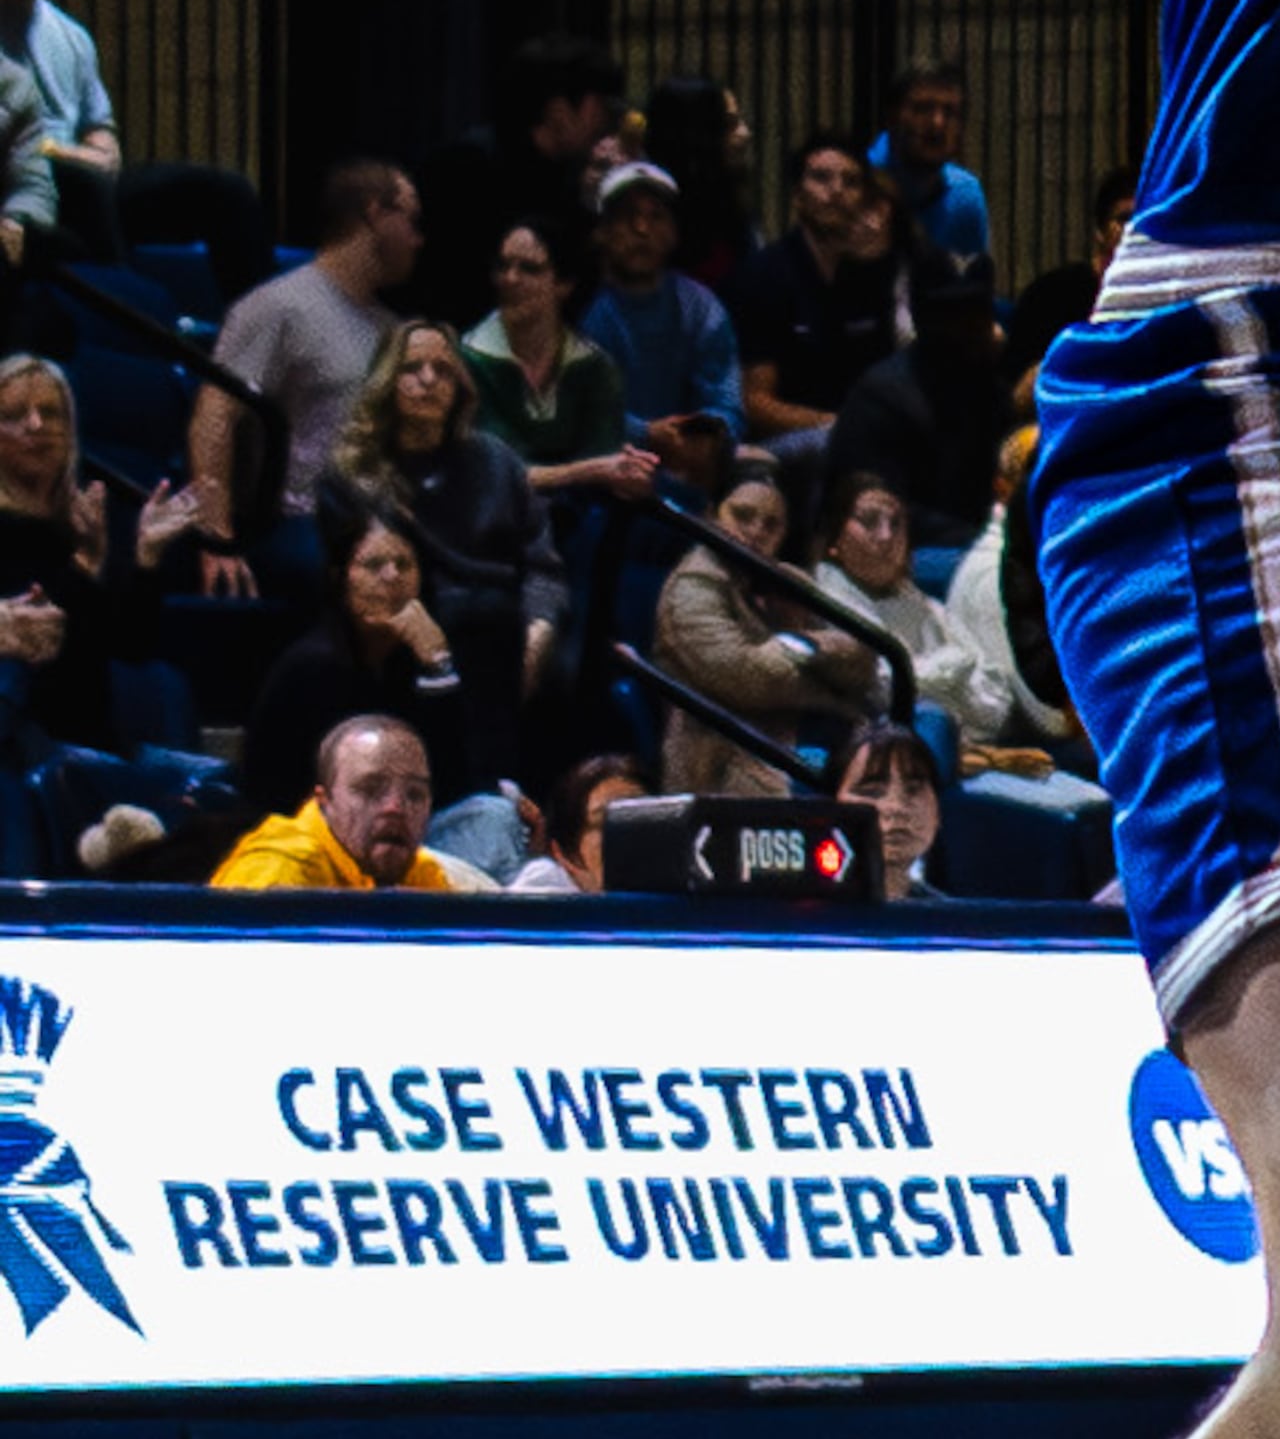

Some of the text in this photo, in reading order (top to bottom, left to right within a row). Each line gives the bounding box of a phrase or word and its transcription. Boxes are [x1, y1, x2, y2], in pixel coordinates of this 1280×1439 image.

[276, 1068, 933, 1152] CASE WESTERN
[1152, 1119, 1250, 1200] VS
[163, 1176, 1073, 1268] RESERVE UNIVERSITY
